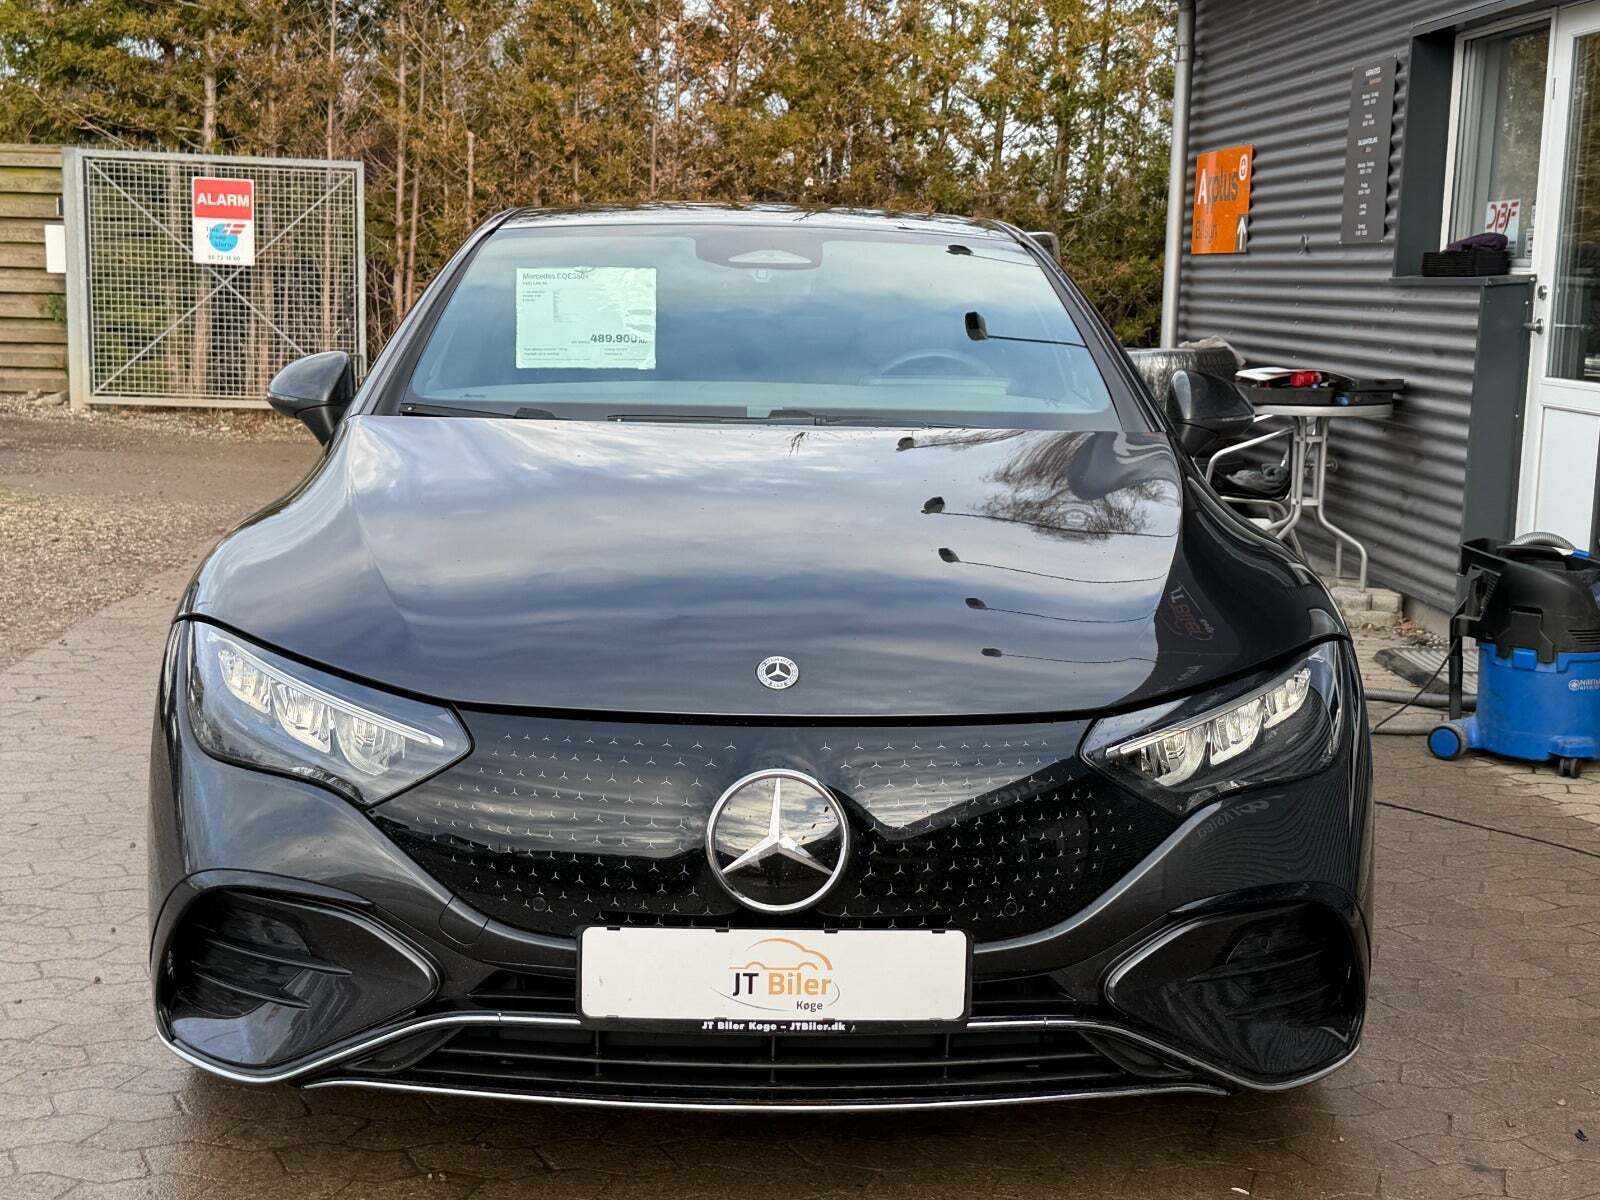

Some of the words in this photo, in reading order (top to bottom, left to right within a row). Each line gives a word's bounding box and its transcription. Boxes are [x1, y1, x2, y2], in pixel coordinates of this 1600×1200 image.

[197, 192, 250, 208] ALARM
[732, 972, 759, 997] JT
[768, 972, 832, 996] Biler
[796, 1000, 824, 1013] Køge
[701, 1021, 714, 1030] JT
[717, 1021, 745, 1030] Biler
[789, 1021, 846, 1031] JTBiler.dk
